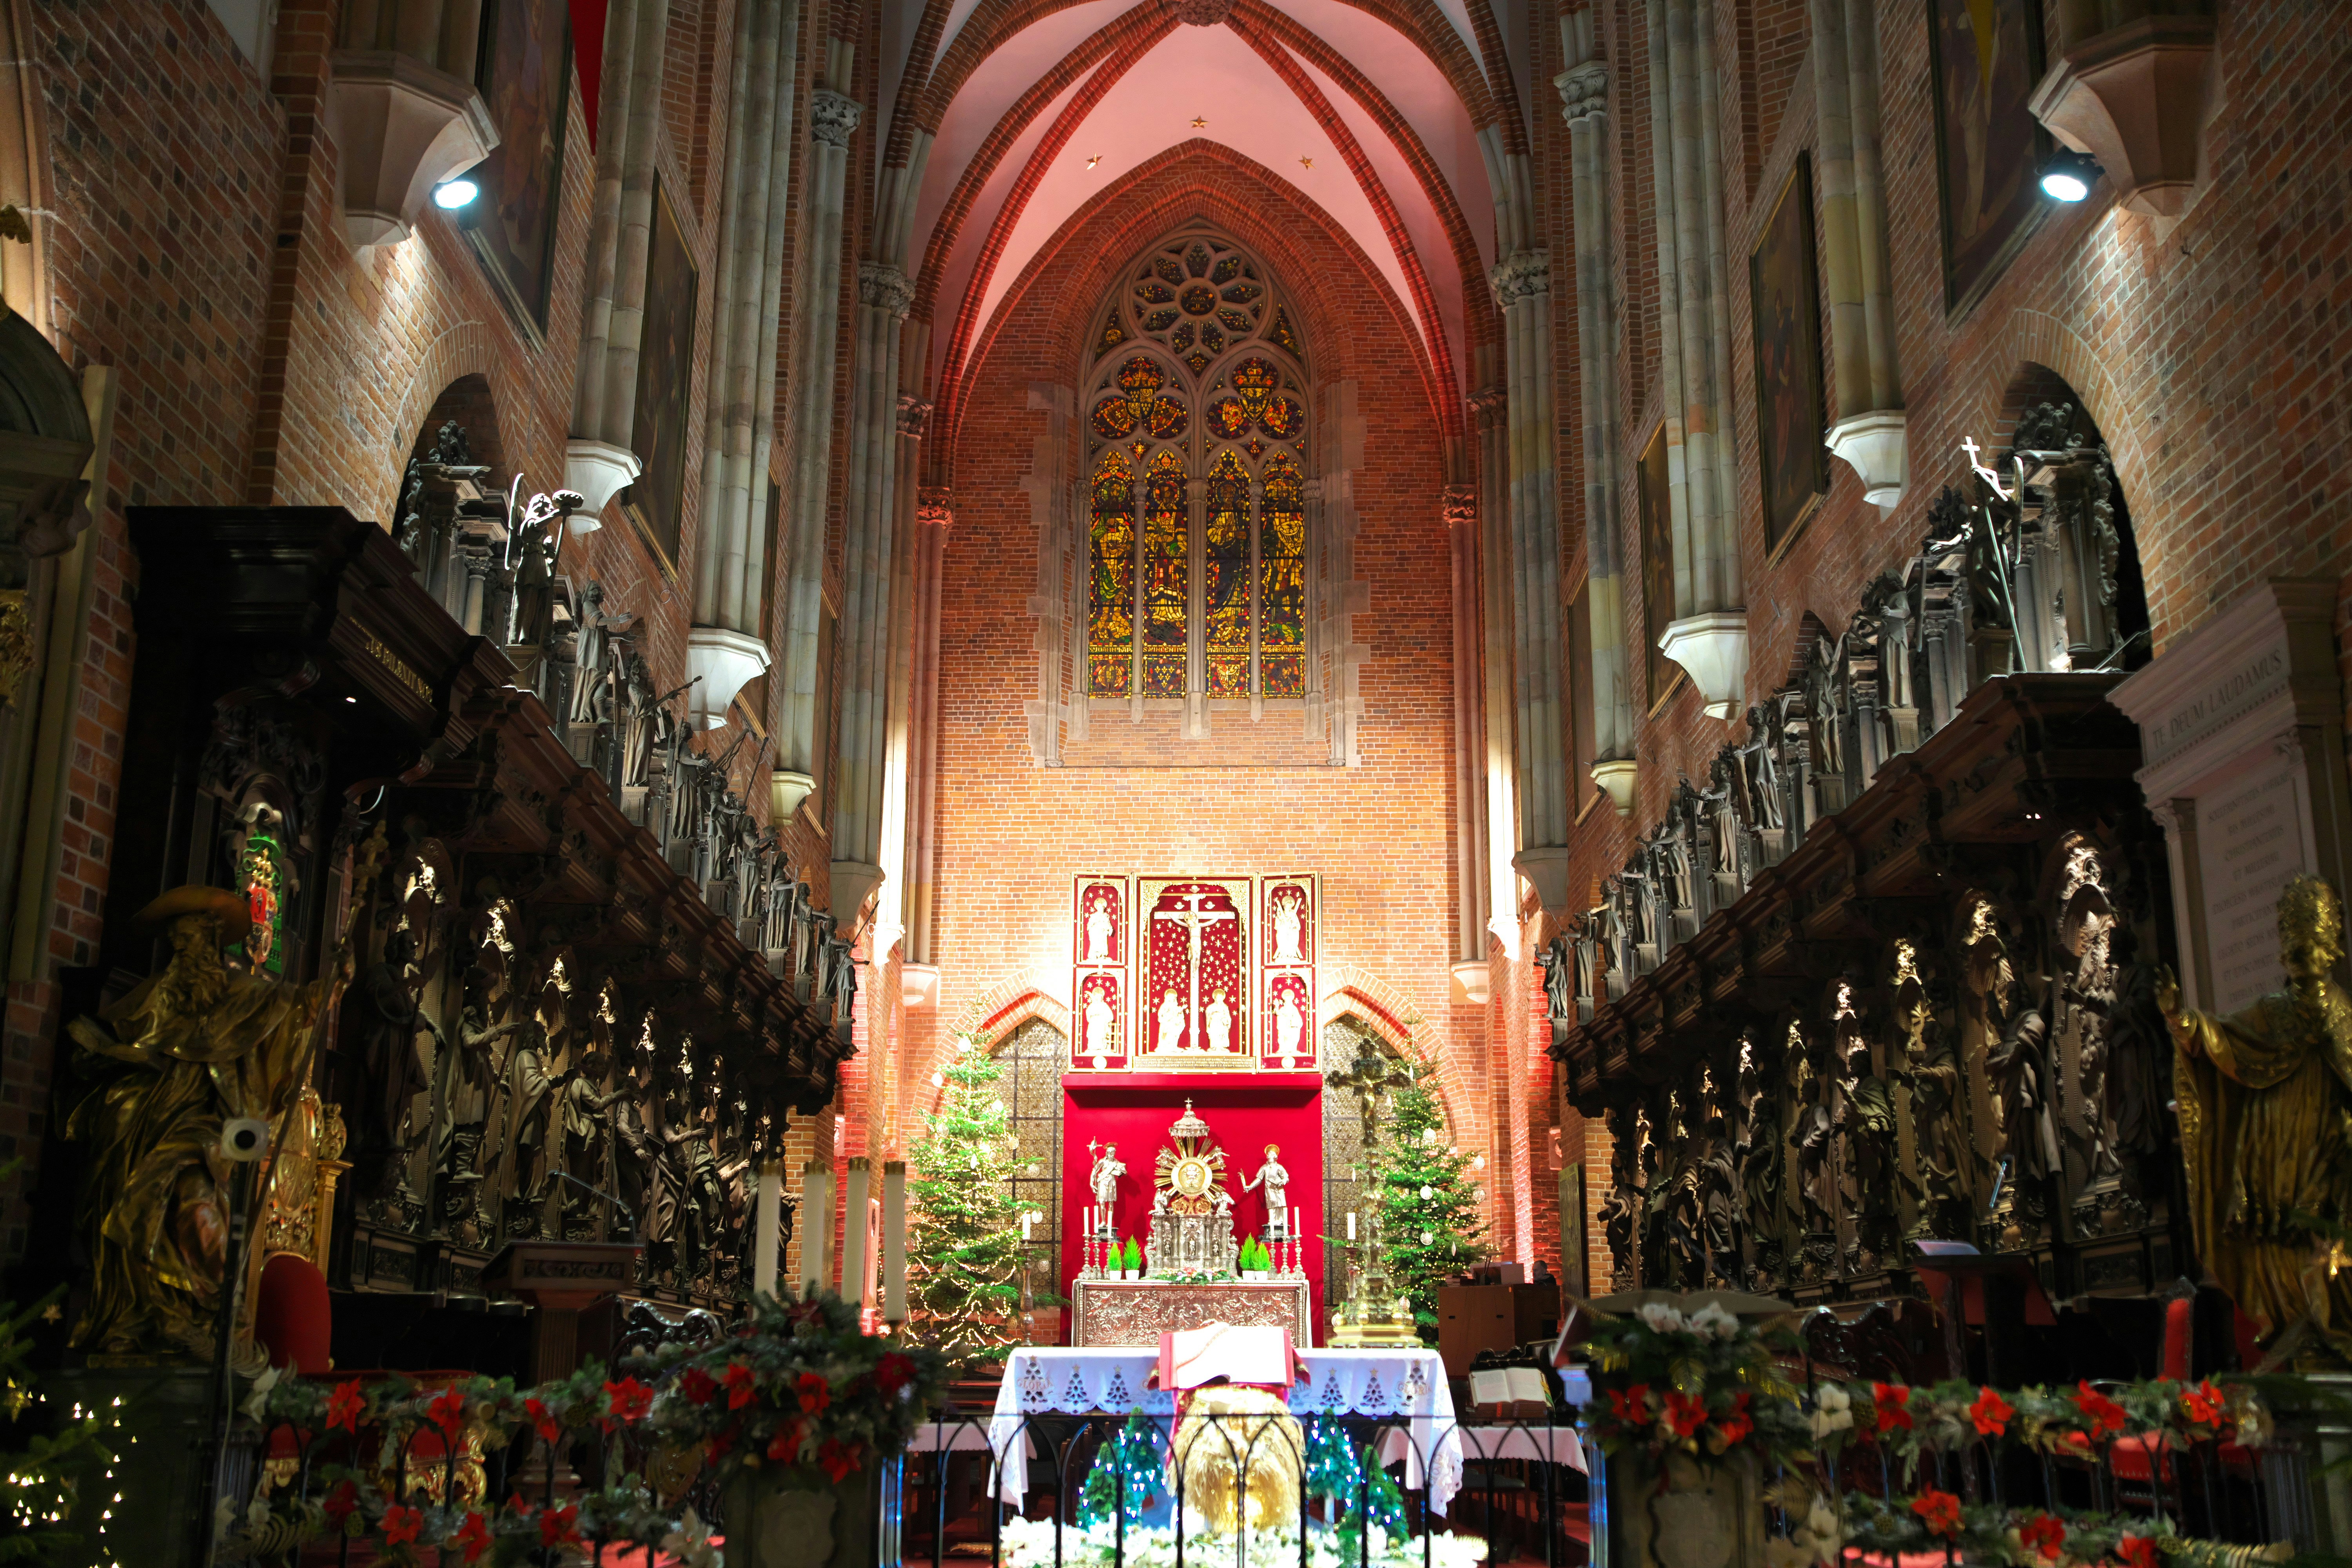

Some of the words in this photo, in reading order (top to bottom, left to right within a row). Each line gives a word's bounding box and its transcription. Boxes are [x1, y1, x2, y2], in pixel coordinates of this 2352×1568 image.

[2153, 725, 2167, 749] TE
[2170, 700, 2205, 738] DEUM
[2209, 649, 2282, 713] LAUDAMUS
